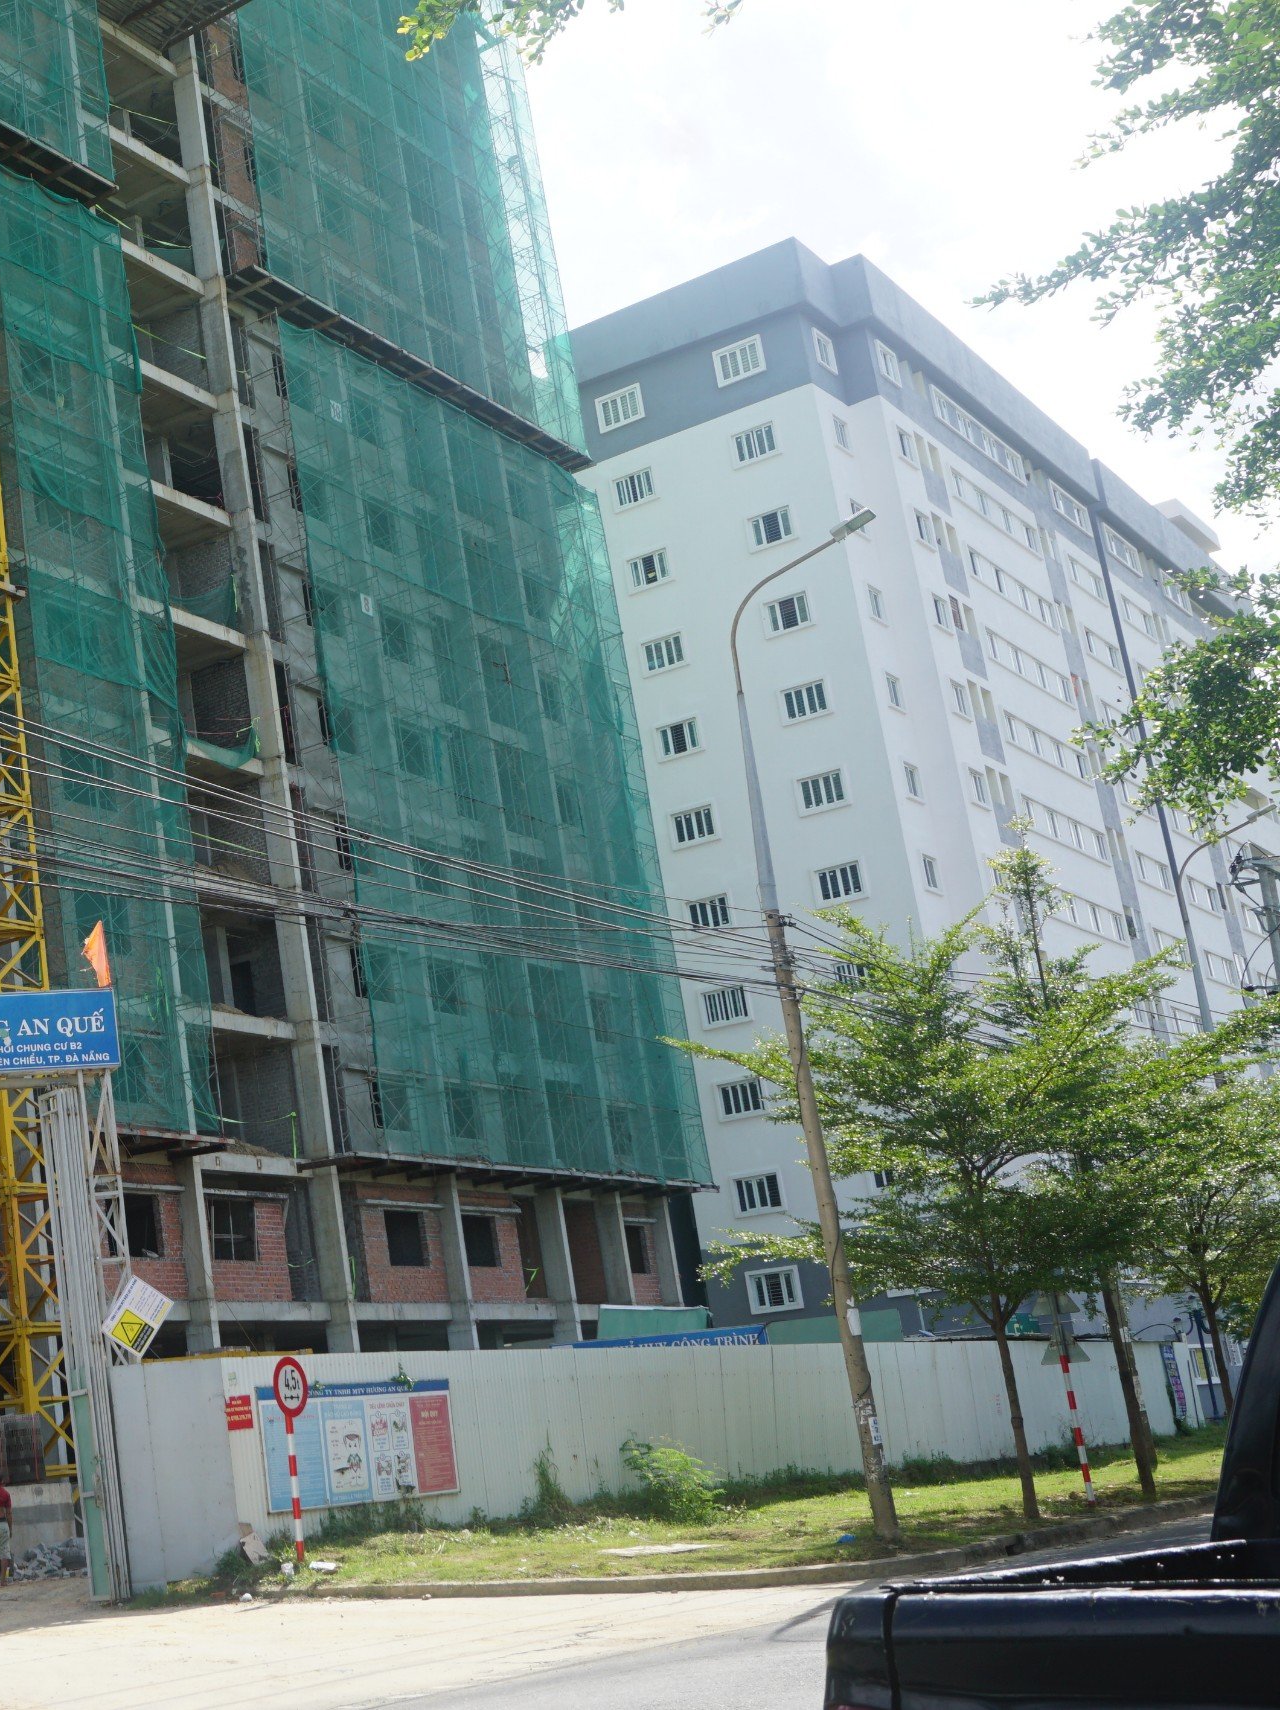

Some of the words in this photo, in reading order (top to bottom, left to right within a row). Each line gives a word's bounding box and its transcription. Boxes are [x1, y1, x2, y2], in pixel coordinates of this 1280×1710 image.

[17, 1018, 50, 1037] AN
[56, 1007, 105, 1038] QUẾ
[16, 1042, 52, 1053] CHUNG
[54, 1041, 69, 1051] CƯ
[70, 1041, 83, 1051] B2
[12, 1054, 46, 1066] CHIỂU,
[47, 1054, 63, 1065] TP.
[65, 1052, 80, 1063] ĐÀ
[81, 1051, 111, 1063] NẴNG
[352, 1387, 365, 1395] MTV
